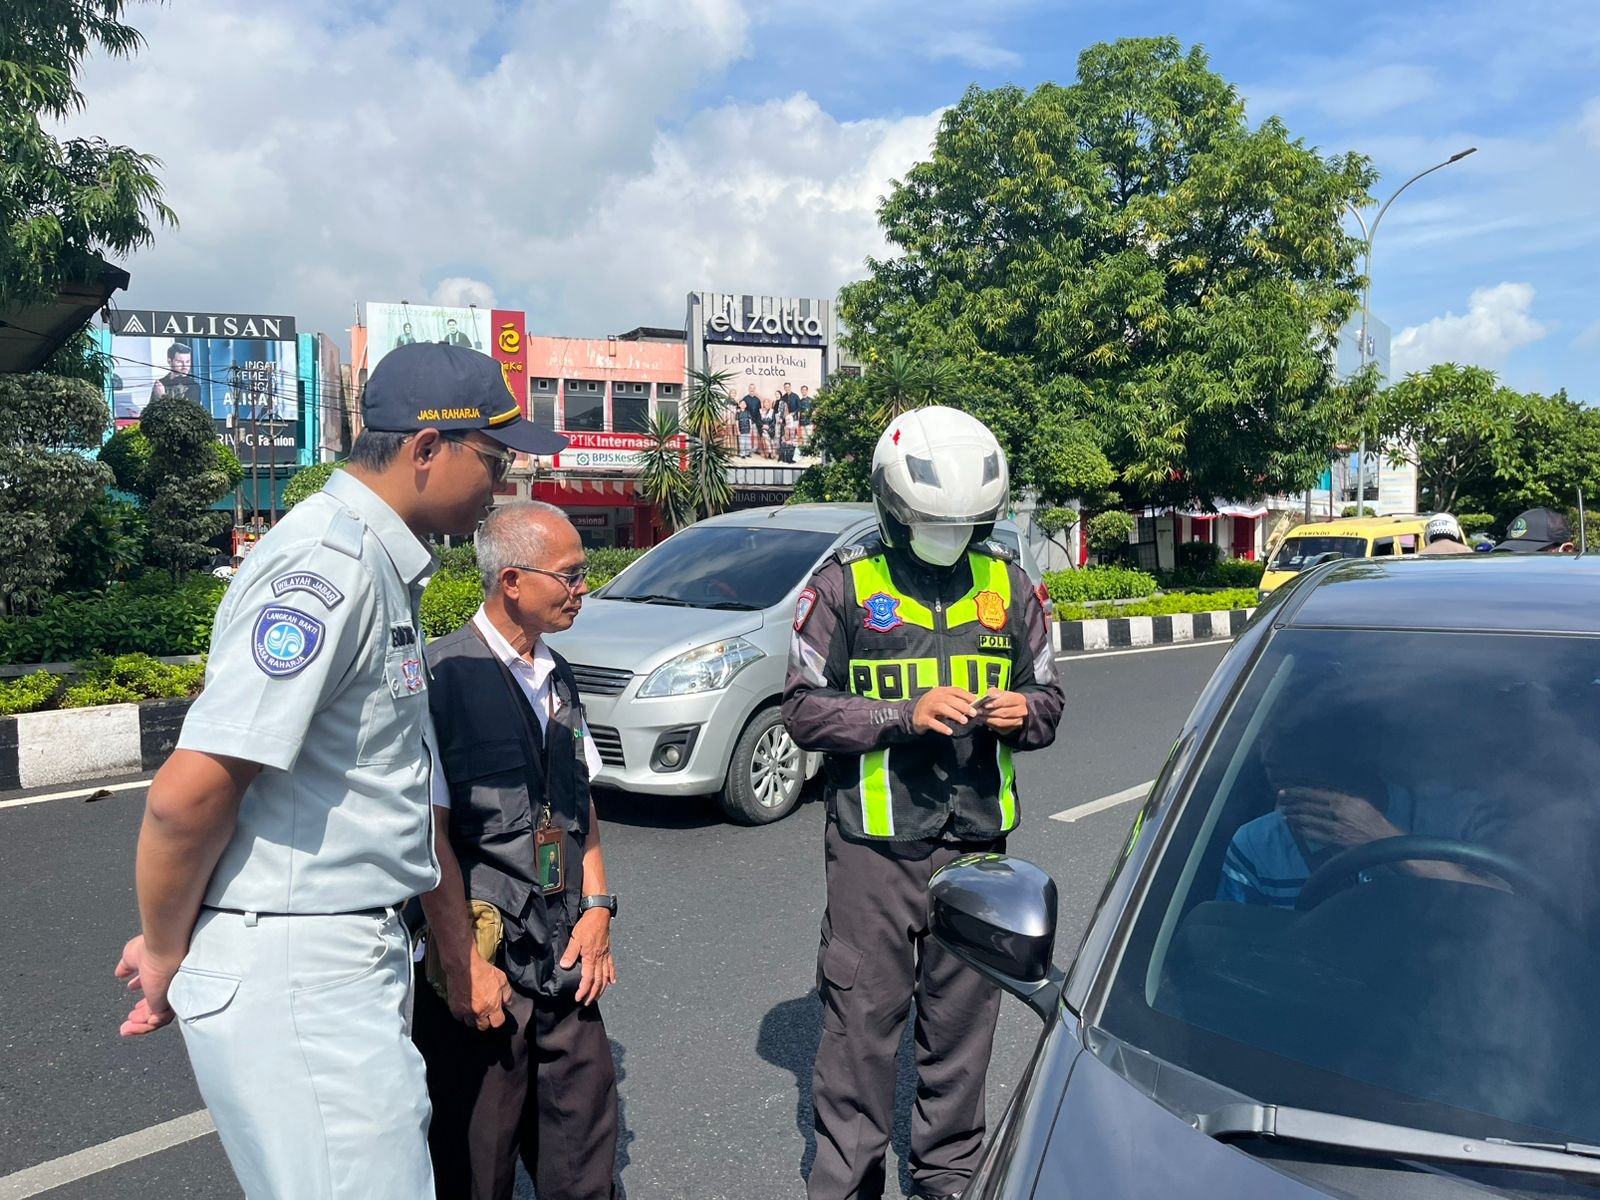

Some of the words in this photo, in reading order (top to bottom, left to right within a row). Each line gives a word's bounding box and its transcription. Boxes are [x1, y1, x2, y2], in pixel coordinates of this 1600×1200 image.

[162, 315, 282, 338] ALISAN
[724, 353, 773, 366] Lebaran
[776, 355, 807, 369] Pakai
[223, 392, 278, 406] AISAN
[417, 409, 440, 421] JASA
[441, 408, 480, 419] RAHARJA
[563, 434, 596, 447] PTIK
[597, 436, 680, 448] Internasial
[592, 453, 614, 462] BPJS
[615, 453, 643, 463] Kese
[731, 492, 756, 502] HIJAB
[758, 492, 790, 503] INDON
[277, 576, 311, 590] WILAYAH
[312, 581, 336, 601] JABAR
[266, 613, 297, 623] LANGKAH
[298, 619, 318, 634] BAKTI
[257, 642, 269, 661] JASA
[267, 655, 305, 668] RAHARJA
